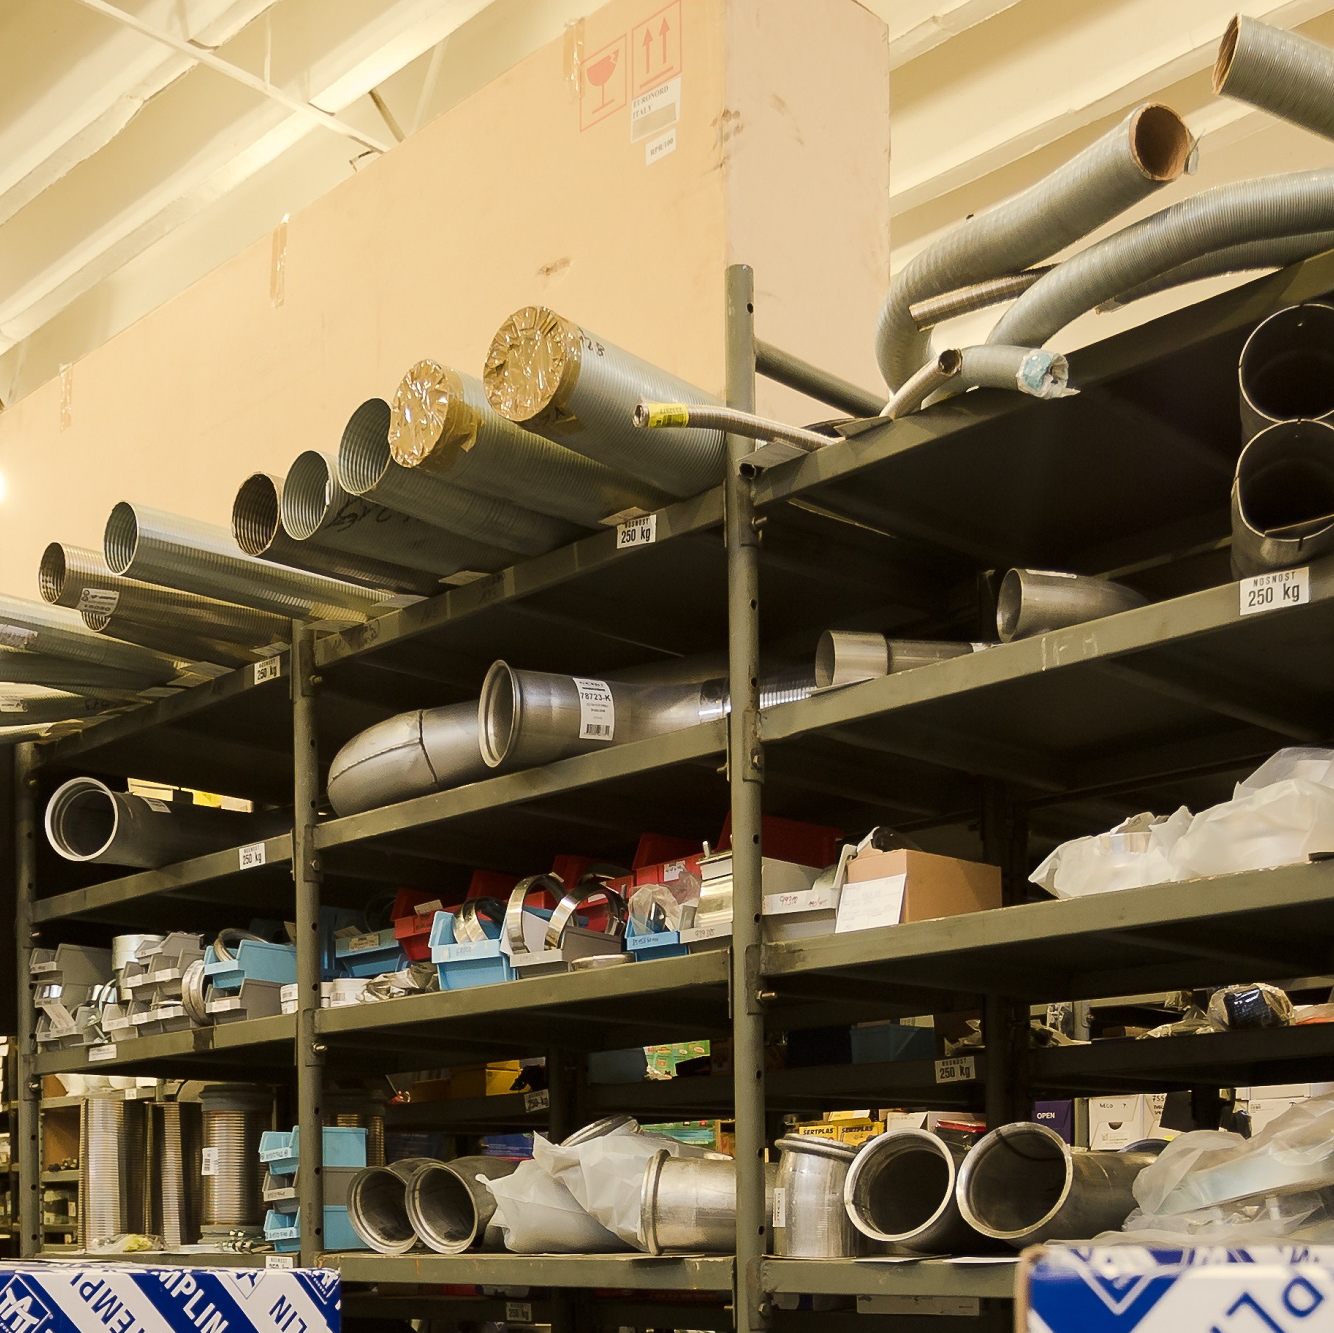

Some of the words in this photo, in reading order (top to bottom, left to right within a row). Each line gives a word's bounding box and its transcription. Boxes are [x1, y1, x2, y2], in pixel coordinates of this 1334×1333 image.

[621, 529, 636, 543] 250
[641, 527, 651, 542] kg
[1253, 571, 1296, 588] NOSNOST
[1248, 587, 1274, 607] 250
[1283, 583, 1300, 603] kg
[1037, 1112, 1055, 1120] OPEN
